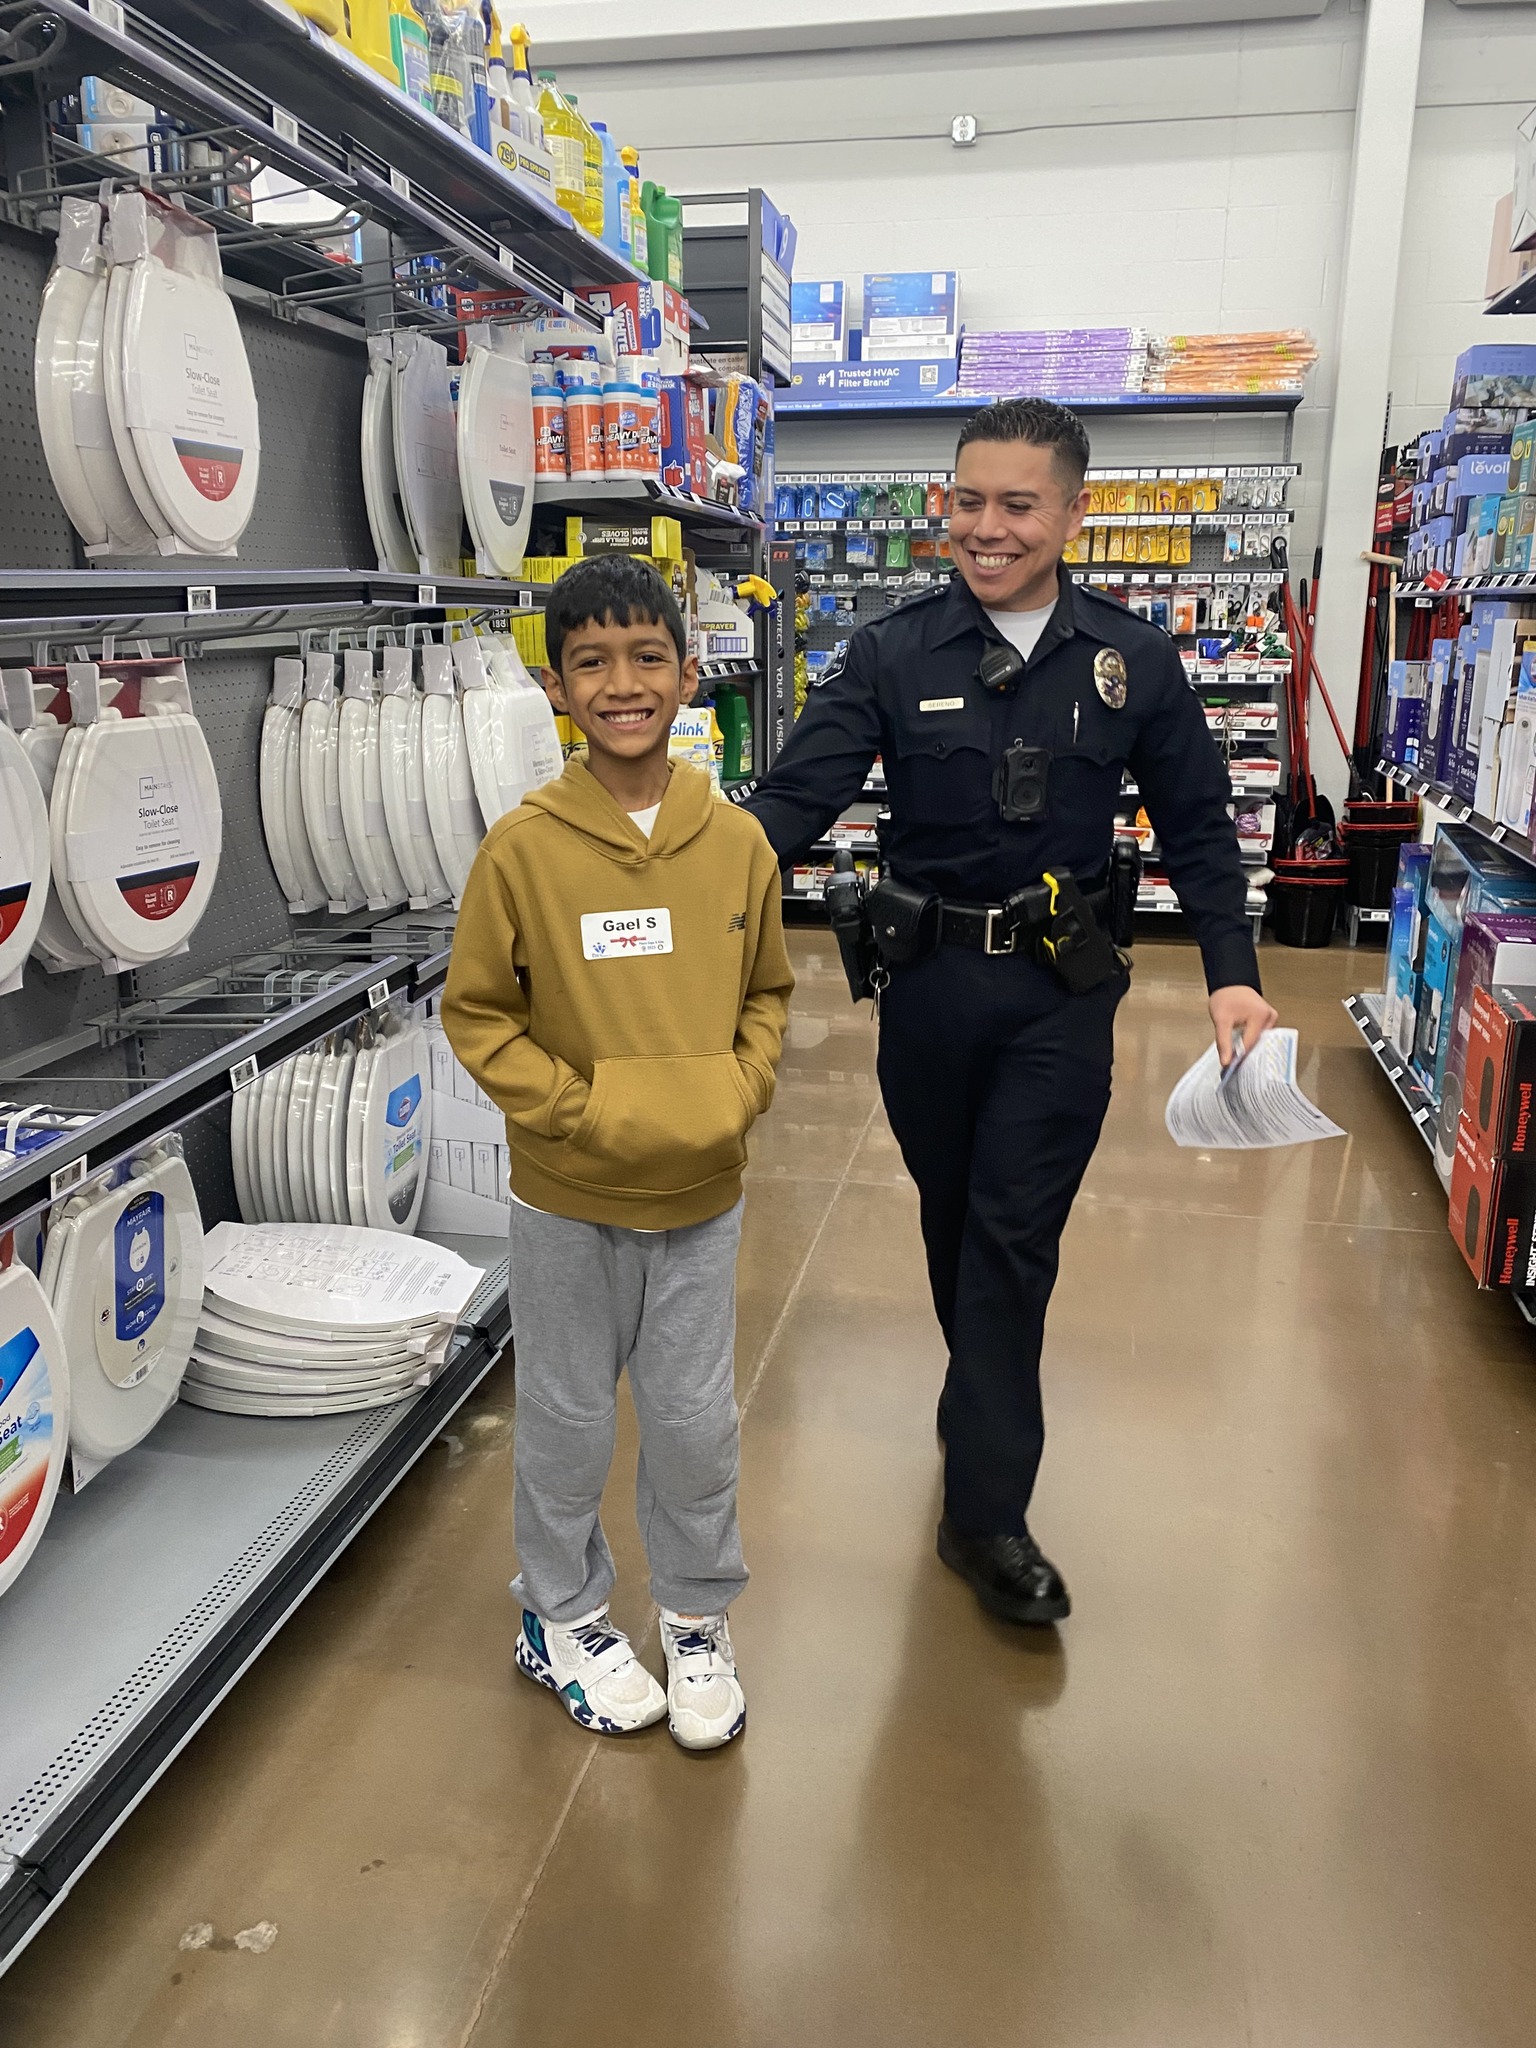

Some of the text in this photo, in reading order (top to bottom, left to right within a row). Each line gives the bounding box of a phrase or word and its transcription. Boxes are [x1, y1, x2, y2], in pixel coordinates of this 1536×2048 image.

[612, 301, 629, 353] WHITE
[185, 367, 221, 386] Slow-Close
[817, 369, 835, 388] #1
[839, 367, 900, 379] Trusted HVAC
[191, 383, 206, 396] Toilet
[839, 378, 862, 388] Filter
[536, 435, 562, 446] HEAVY
[587, 436, 603, 444] HEA
[606, 431, 631, 443] HEAVY
[601, 530, 630, 538] GLOVES
[632, 536, 649, 546] 100
[776, 666, 784, 698] YOUR
[138, 804, 179, 818] Slow-Close
[143, 817, 175, 830] Toilet Seat
[167, 890, 173, 902] R
[602, 916, 657, 932] Gael S
[1511, 1083, 1533, 1152] Honeywell
[126, 1206, 152, 1228] MAYFAIR
[1499, 1218, 1520, 1285] Honeywell
